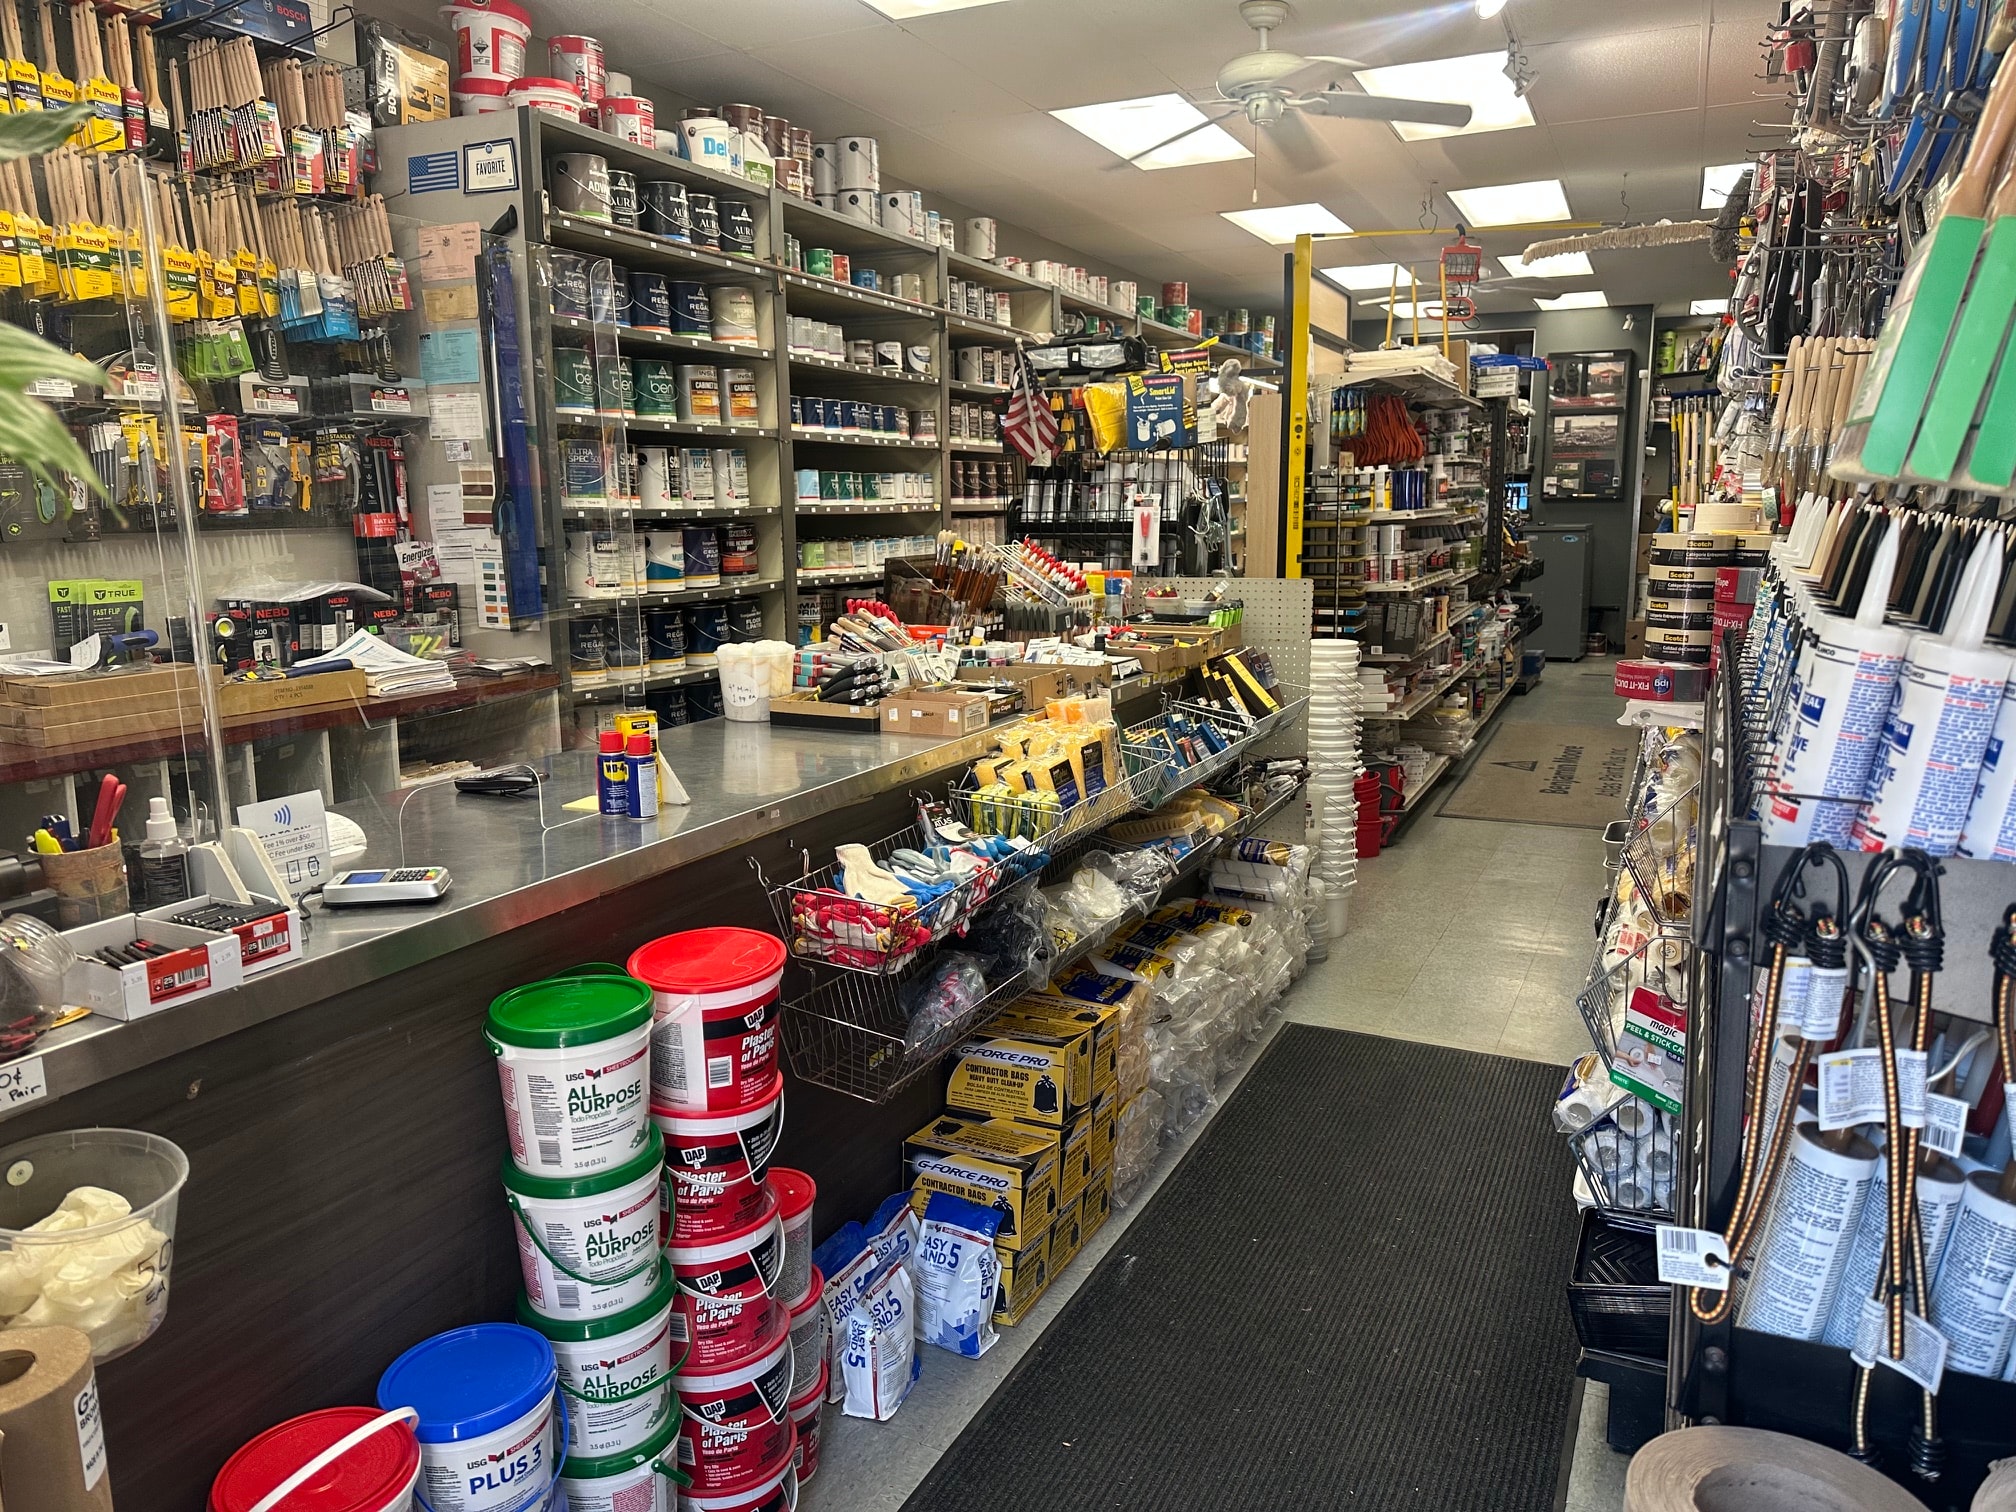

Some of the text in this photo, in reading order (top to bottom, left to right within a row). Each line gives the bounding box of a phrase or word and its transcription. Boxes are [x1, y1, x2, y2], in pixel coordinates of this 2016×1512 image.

[276, 4, 307, 23] BOSCH
[15, 69, 36, 81] Purdy
[45, 84, 73, 98] Purdy
[93, 87, 119, 101] Purdy
[475, 160, 506, 176] FAVORITE
[17, 225, 37, 235] Purdy
[76, 235, 105, 248] Purdy
[168, 258, 192, 269] Purdy
[217, 270, 234, 281] Purdy
[650, 381, 673, 394] ben
[1149, 387, 1175, 396] SmartLid
[568, 448, 593, 456] ULTRA
[568, 455, 589, 463] SPEC
[402, 546, 434, 563] Energizer
[108, 590, 137, 598] TRUE
[328, 596, 349, 604] NEBO
[428, 590, 452, 599] NEBO
[93, 607, 122, 616] FAST FLIP
[256, 608, 290, 619] NEBO
[373, 609, 398, 619] NEBO
[1628, 682, 1650, 690] FIX-IT
[1654, 678, 1669, 688] ipg
[1539, 746, 1584, 794] Benjamin Moore
[299, 833, 310, 841] $50
[275, 842, 316, 857] Fee under $50
[248, 943, 257, 951] 25
[163, 976, 173, 985] 25
[747, 1008, 763, 1025] DAP
[1626, 1022, 1642, 1036] PEEL
[1651, 1034, 1671, 1048] STICK
[1650, 1020, 1678, 1037] magic
[742, 1024, 775, 1051] Plaster
[741, 1037, 775, 1062] of Paris
[960, 1046, 1050, 1067] G-FORCE PRO
[566, 1072, 585, 1082] USG
[965, 1063, 1030, 1081] CONTRACTOR BAGS
[970, 1074, 1024, 1088] HEAVY DUTY CLEAN-UP
[9, 1084, 41, 1101] Pair
[567, 1084, 602, 1102] ALL
[568, 1079, 641, 1116] PURPOSE
[685, 1148, 705, 1162] DAP
[917, 1159, 1009, 1188] G-FORCE PRO
[678, 1184, 725, 1197] of Paris
[921, 1177, 987, 1202] CONTRACTOR BAGS
[584, 1218, 602, 1228] USG
[585, 1229, 618, 1248] ALL
[586, 1219, 654, 1261] PURPOSE
[924, 1236, 948, 1252] ASY
[874, 1238, 893, 1262] EASY
[947, 1243, 962, 1269] 5
[700, 1273, 721, 1289] DAP
[695, 1291, 743, 1311] Plater
[828, 1286, 852, 1312] EASY
[886, 1289, 902, 1316] 5
[696, 1303, 743, 1323] of Paris
[581, 1363, 599, 1371] USG
[848, 1352, 866, 1368] 5
[583, 1374, 616, 1389] ALL
[583, 1364, 657, 1399] PURPOSE
[704, 1402, 725, 1417] DAP
[701, 1419, 747, 1437] Plater
[702, 1431, 748, 1448] of Paris
[467, 1458, 488, 1470] USG
[469, 1441, 542, 1495] PLUS 3
